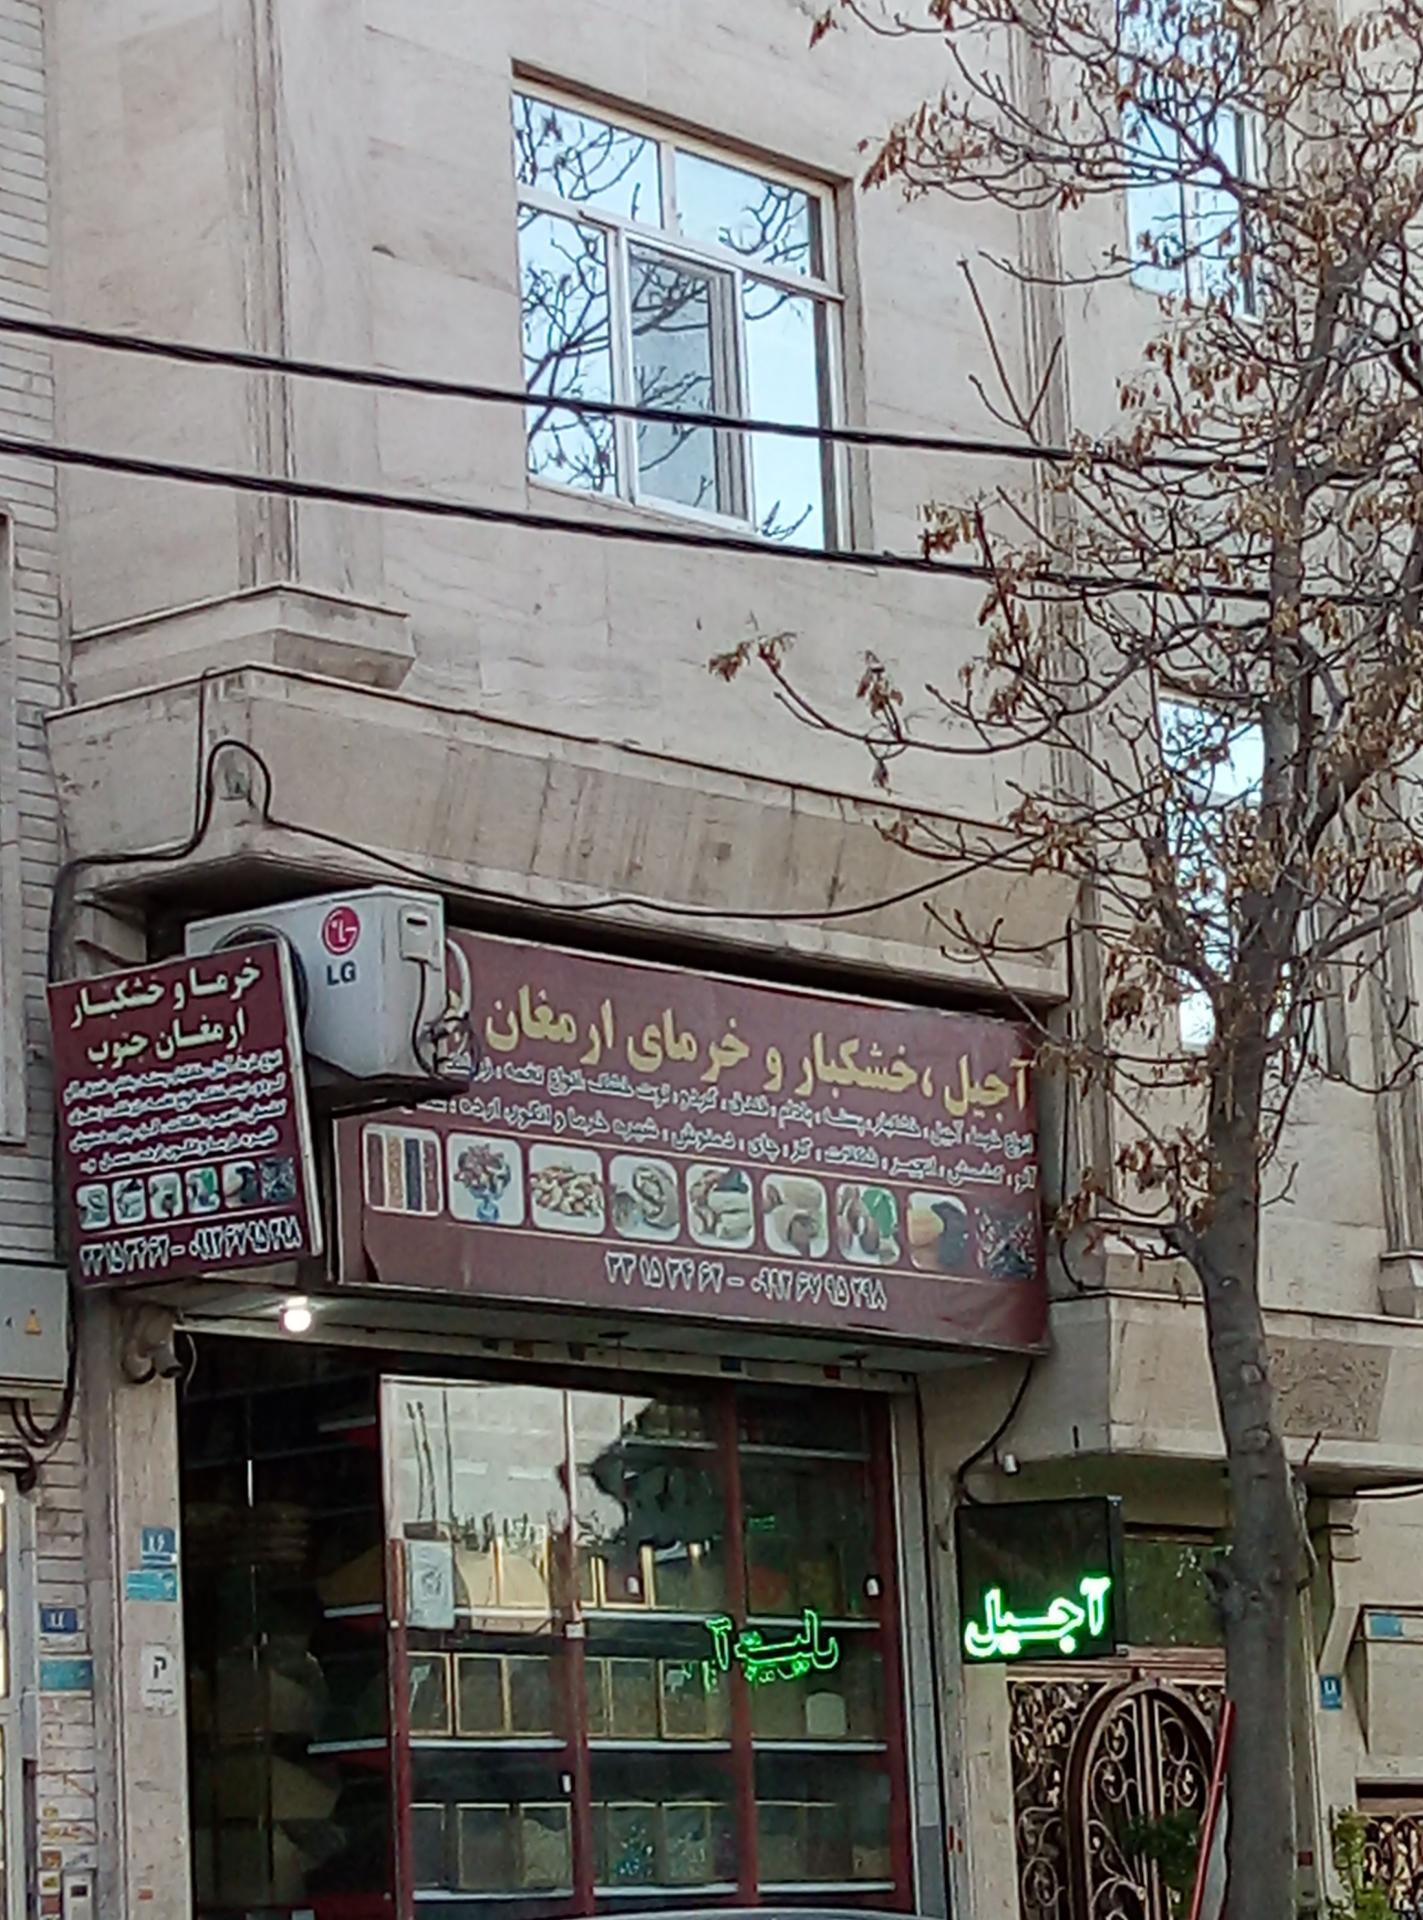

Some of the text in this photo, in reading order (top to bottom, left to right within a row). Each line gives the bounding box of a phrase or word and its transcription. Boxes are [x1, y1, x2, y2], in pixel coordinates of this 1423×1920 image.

[70, 957, 260, 1029] خرما و خشکبار
[327, 961, 356, 985] LG
[87, 1007, 246, 1070] ارمغان جنوب
[486, 984, 614, 1066] ارمغان
[627, 1008, 750, 1084] خرمای
[764, 1046, 782, 1092] و
[964, 1576, 1111, 1659] آجیل
